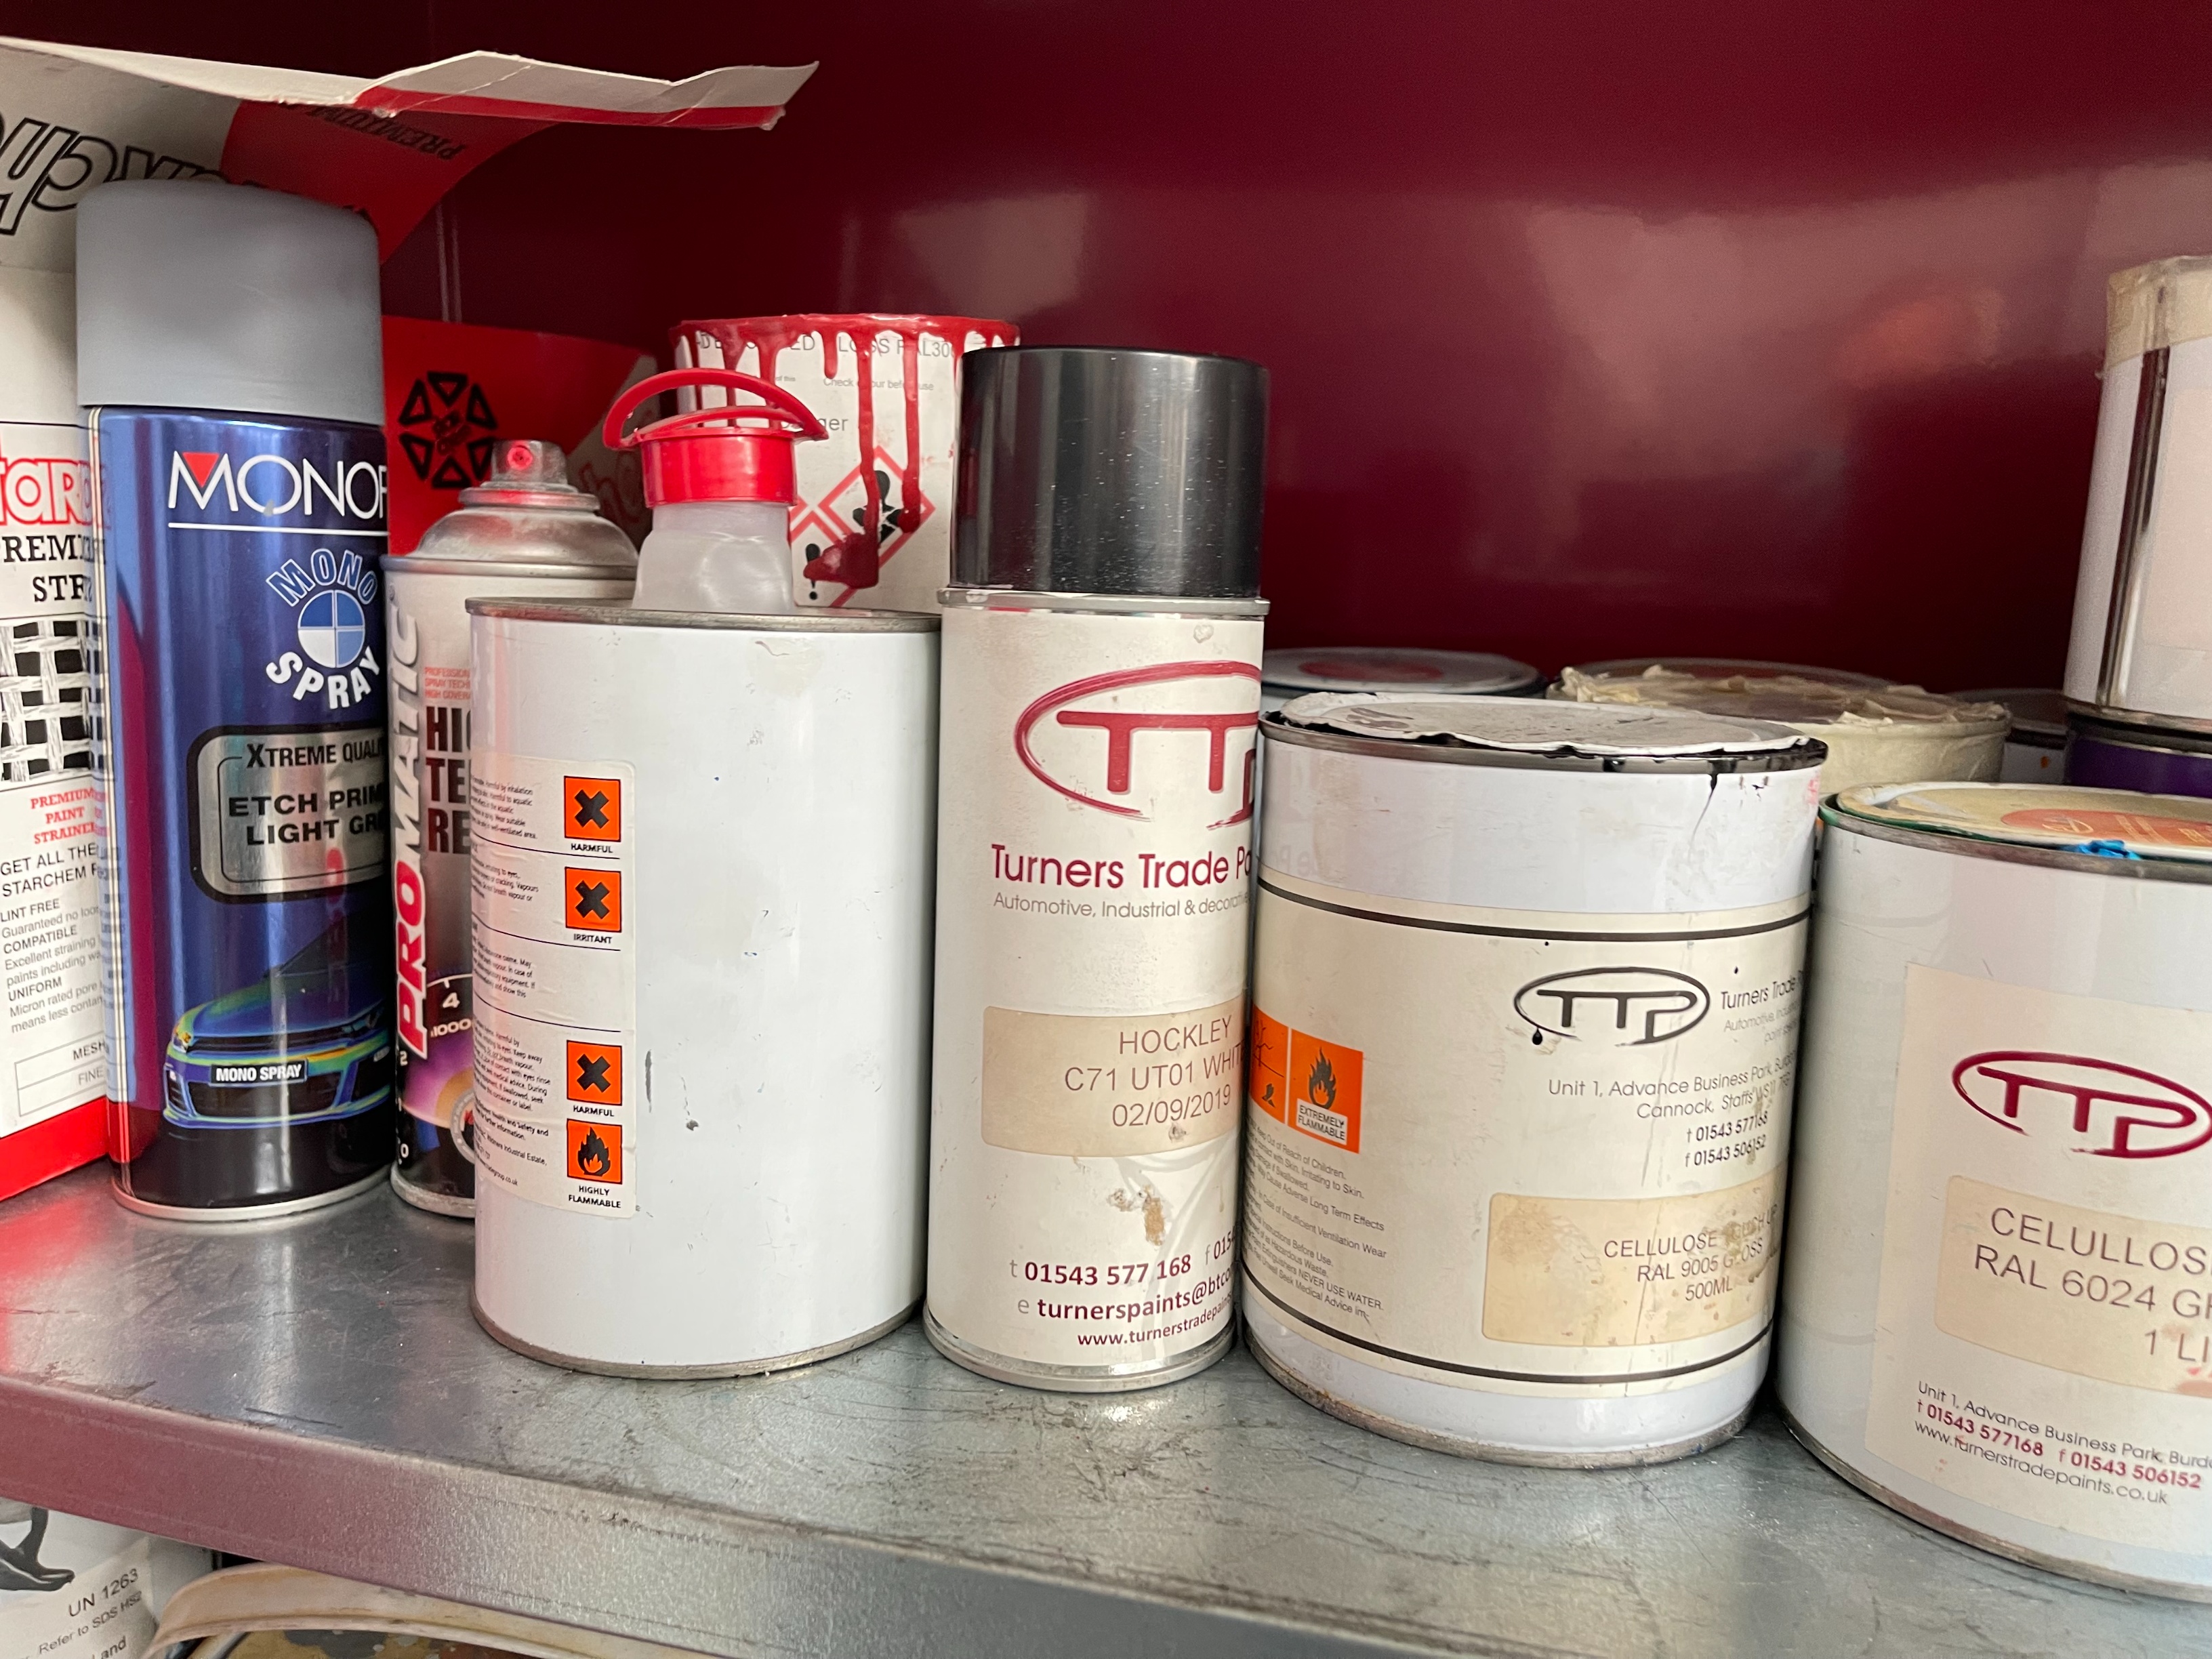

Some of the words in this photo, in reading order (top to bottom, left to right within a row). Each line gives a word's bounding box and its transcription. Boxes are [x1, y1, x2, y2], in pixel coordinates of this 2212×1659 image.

[823, 377, 854, 387] Check
[266, 548, 378, 607] MONO
[266, 645, 381, 710] SPRAY
[246, 743, 336, 769] XTREME
[426, 758, 470, 804] TE
[30, 787, 95, 809] PREMIUM
[228, 793, 318, 817] ETCH
[45, 806, 85, 824] PAINT
[247, 819, 339, 846] LIGHT
[428, 808, 470, 855] RE
[1, 857, 31, 876] GET
[37, 851, 64, 868] ALL
[68, 842, 97, 859] THE
[571, 843, 614, 854] HARMFUL
[3, 865, 86, 897] STARCHEM
[991, 844, 1124, 889] Turners
[1139, 851, 1229, 889] Trade
[0, 906, 26, 922] LINT
[30, 898, 60, 916] FREE
[994, 892, 1097, 918] Automotive,
[1102, 900, 1180, 918] Industrial
[1185, 899, 1195, 916] &
[1, 915, 63, 938] Guaranteed
[66, 911, 79, 922] no
[4, 924, 78, 954] COMPATIBLE
[573, 933, 613, 945] IRRITANT
[5, 949, 52, 970] Excellent
[54, 936, 96, 957] straining
[7, 968, 39, 989] paints
[41, 954, 85, 977] including
[8, 977, 62, 1002] UNIFORM
[9, 999, 45, 1017] Micron
[47, 990, 73, 1005] rated
[76, 983, 98, 998] pore
[443, 991, 460, 1008] 4
[1721, 987, 1769, 1010] Turners
[11, 1015, 47, 1033] means
[49, 1006, 68, 1021] less
[1536, 989, 1698, 1040] TTP
[1119, 1015, 1233, 1054] HOCKLEY
[73, 1038, 108, 1061] MESH
[400, 1051, 408, 1065] 2
[78, 1065, 104, 1086] FINE
[216, 1067, 257, 1082] MONO
[260, 1063, 302, 1082] SPRAY
[1065, 1067, 1117, 1092] C71
[1132, 1061, 1193, 1091] UT01
[1549, 1079, 1585, 1097] Unit
[1593, 1080, 1603, 1098] 1,
[1608, 1080, 1689, 1097] Advance
[1694, 1071, 1748, 1092] Business
[527, 1083, 548, 1097] During
[1637, 1096, 1715, 1119] Cannock,
[1721, 1090, 1754, 1113] Staffs
[573, 1105, 615, 1118] HARMFUL
[1111, 1083, 1232, 1128] 02/09/2019
[1299, 1105, 1345, 1128] EXTREMELY
[1977, 1065, 2197, 1152] TTP
[1297, 1115, 1345, 1141] FLAMMABLE
[1686, 1128, 1693, 1143] t
[1696, 1122, 1733, 1142] 01543
[1282, 1144, 1302, 1161] Reach
[1303, 1156, 1311, 1165] of
[1311, 1158, 1347, 1180] Children.
[1685, 1152, 1691, 1168] f
[1694, 1146, 1731, 1166] 01543
[1733, 1134, 1767, 1158] 506152
[578, 1185, 610, 1196] HIGHLY
[1301, 1166, 1330, 1189] Irritating
[1332, 1180, 1341, 1191] to
[1343, 1183, 1365, 1199] Skin.
[568, 1194, 621, 1209] FLAMMABLE
[1283, 1183, 1308, 1204] Adverse
[1310, 1196, 1328, 1214] Long
[1331, 1205, 1351, 1221] Term
[1353, 1214, 1385, 1231] Effects
[1292, 1239, 1314, 1258] Before
[1316, 1251, 1334, 1267] Use.
[1317, 1227, 1360, 1250] Ventilation
[1362, 1242, 1387, 1258] Wear
[1603, 1230, 1718, 1258] CELLULOSE
[1991, 1207, 2212, 1276] CELULLOS
[1009, 1258, 1018, 1278] t
[1025, 1261, 1099, 1286] 01543
[1106, 1263, 1149, 1286] 577
[1156, 1254, 1192, 1280] 168
[1205, 1244, 1211, 1265] f
[1303, 1258, 1328, 1277] Waste.
[1637, 1263, 1675, 1282] RAL
[1681, 1254, 1719, 1277] 9005
[1723, 1237, 1763, 1269] GOSS
[1279, 1269, 1295, 1286] Seek
[1295, 1280, 1323, 1302] Medical
[1324, 1294, 1357, 1313] Advice
[1298, 1271, 1325, 1289] NEVER
[1326, 1284, 1345, 1298] USE
[1347, 1289, 1385, 1311] WATER.
[1685, 1275, 1734, 1301] 500ML
[1975, 1244, 2047, 1289] RAL
[2062, 1269, 2156, 1312] 6024
[1017, 1298, 1030, 1315] e
[2144, 1328, 2157, 1356] 1
[2177, 1332, 2210, 1363] LI
[1918, 1380, 1946, 1402] Unit
[1951, 1393, 1960, 1409] 1,
[1964, 1400, 2040, 1434] Advance
[2045, 1425, 2116, 1454] Business
[1917, 1399, 1923, 1414] t
[1927, 1404, 1975, 1434] 01543
[1980, 1425, 2044, 1457] 577168
[2059, 1448, 2066, 1463] f
[2071, 1450, 2127, 1476] 01543
[2133, 1465, 2203, 1490] 506152
[1914, 1420, 2169, 1504] www.turnerstradepaints.co.uk
[68, 1593, 96, 1617] UN
[102, 1568, 139, 1599] 1263
[39, 1633, 74, 1655] Refer
[78, 1625, 89, 1637] to
[92, 1606, 118, 1629] SDS
